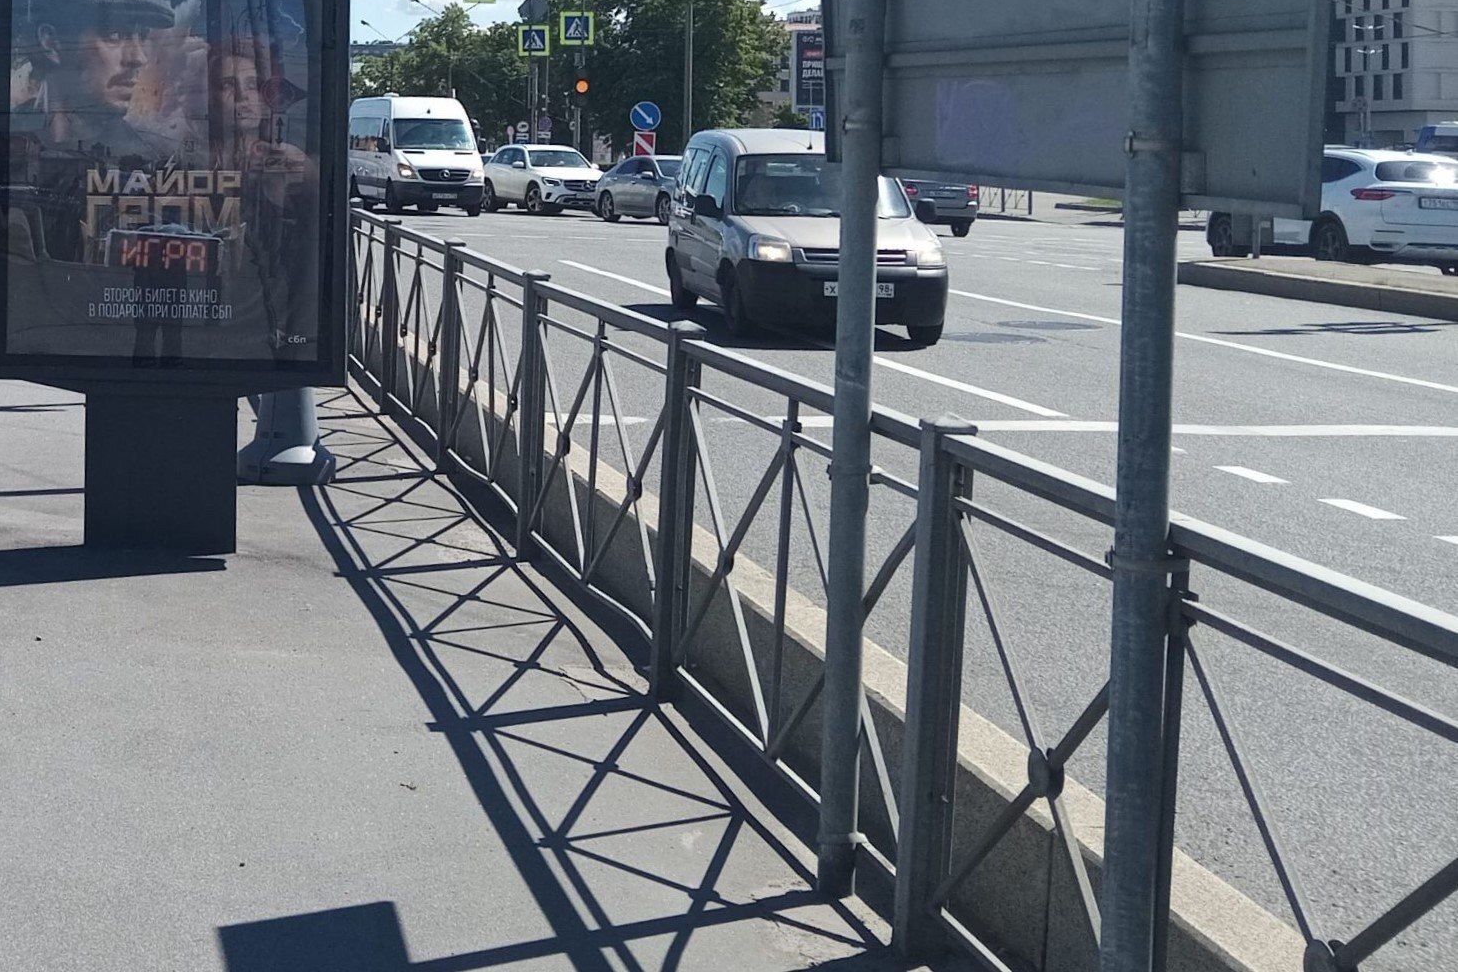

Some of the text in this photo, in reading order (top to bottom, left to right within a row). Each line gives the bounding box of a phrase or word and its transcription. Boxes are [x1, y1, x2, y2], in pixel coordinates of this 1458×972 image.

[86, 157, 242, 195] МАЙОР
[121, 238, 207, 273] ИГРА
[103, 286, 218, 304] ВТОРОЙ БИЛЕТ В КИНО
[88, 303, 233, 320] В ПОДАРОК ПРИ ОПЛАТЕ СБП
[287, 334, 307, 344] сбп
